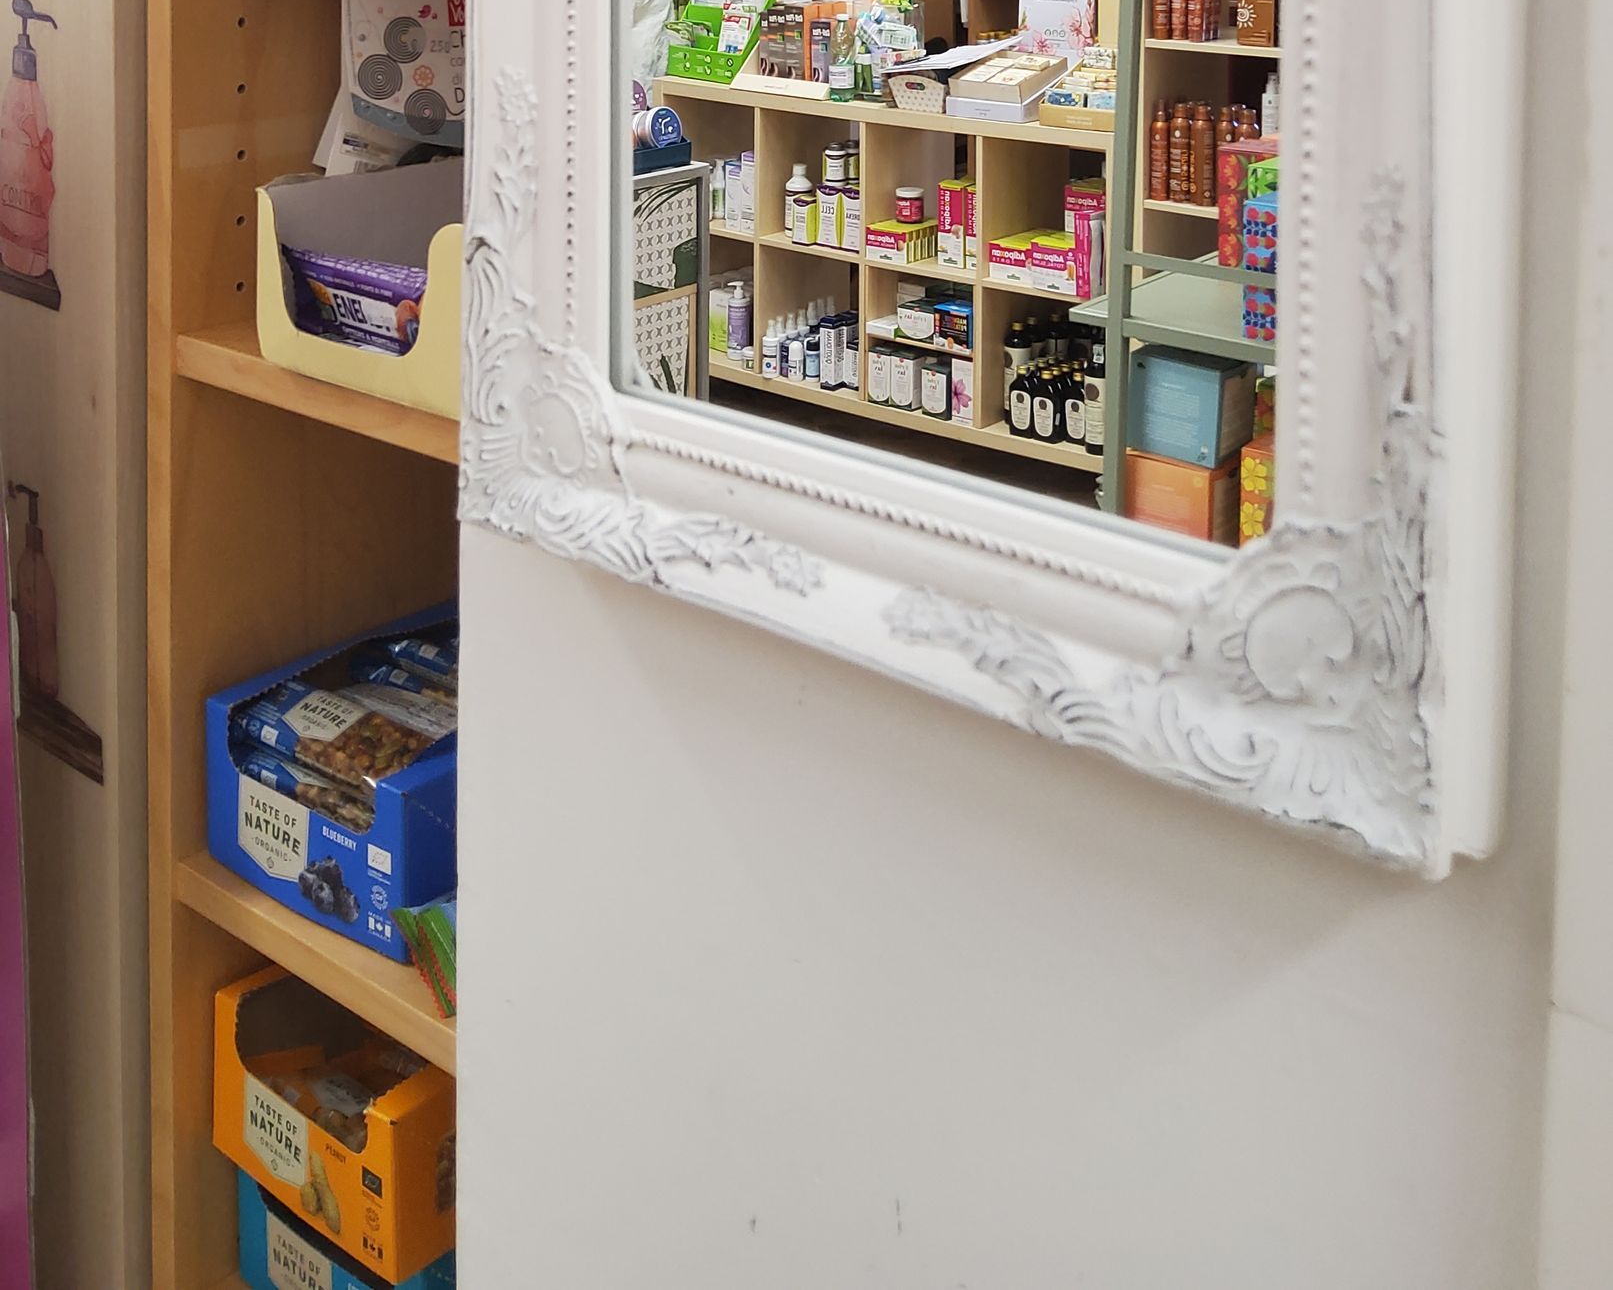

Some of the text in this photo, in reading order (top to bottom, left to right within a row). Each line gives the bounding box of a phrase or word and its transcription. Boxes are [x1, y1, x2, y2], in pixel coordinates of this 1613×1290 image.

[300, 701, 347, 729] NATURE
[317, 695, 341, 711] TASTE
[249, 795, 297, 828] TASTE OF
[245, 811, 301, 855] NATURE
[322, 825, 357, 851] BLUEBERRY
[255, 836, 289, 862] ORGANIC
[254, 1094, 298, 1135] TASTE OF
[249, 1109, 301, 1164] NATURE
[259, 1136, 291, 1167] ORGANIC
[325, 1143, 347, 1165] PEANUT
[277, 1234, 320, 1275] TASTE OF
